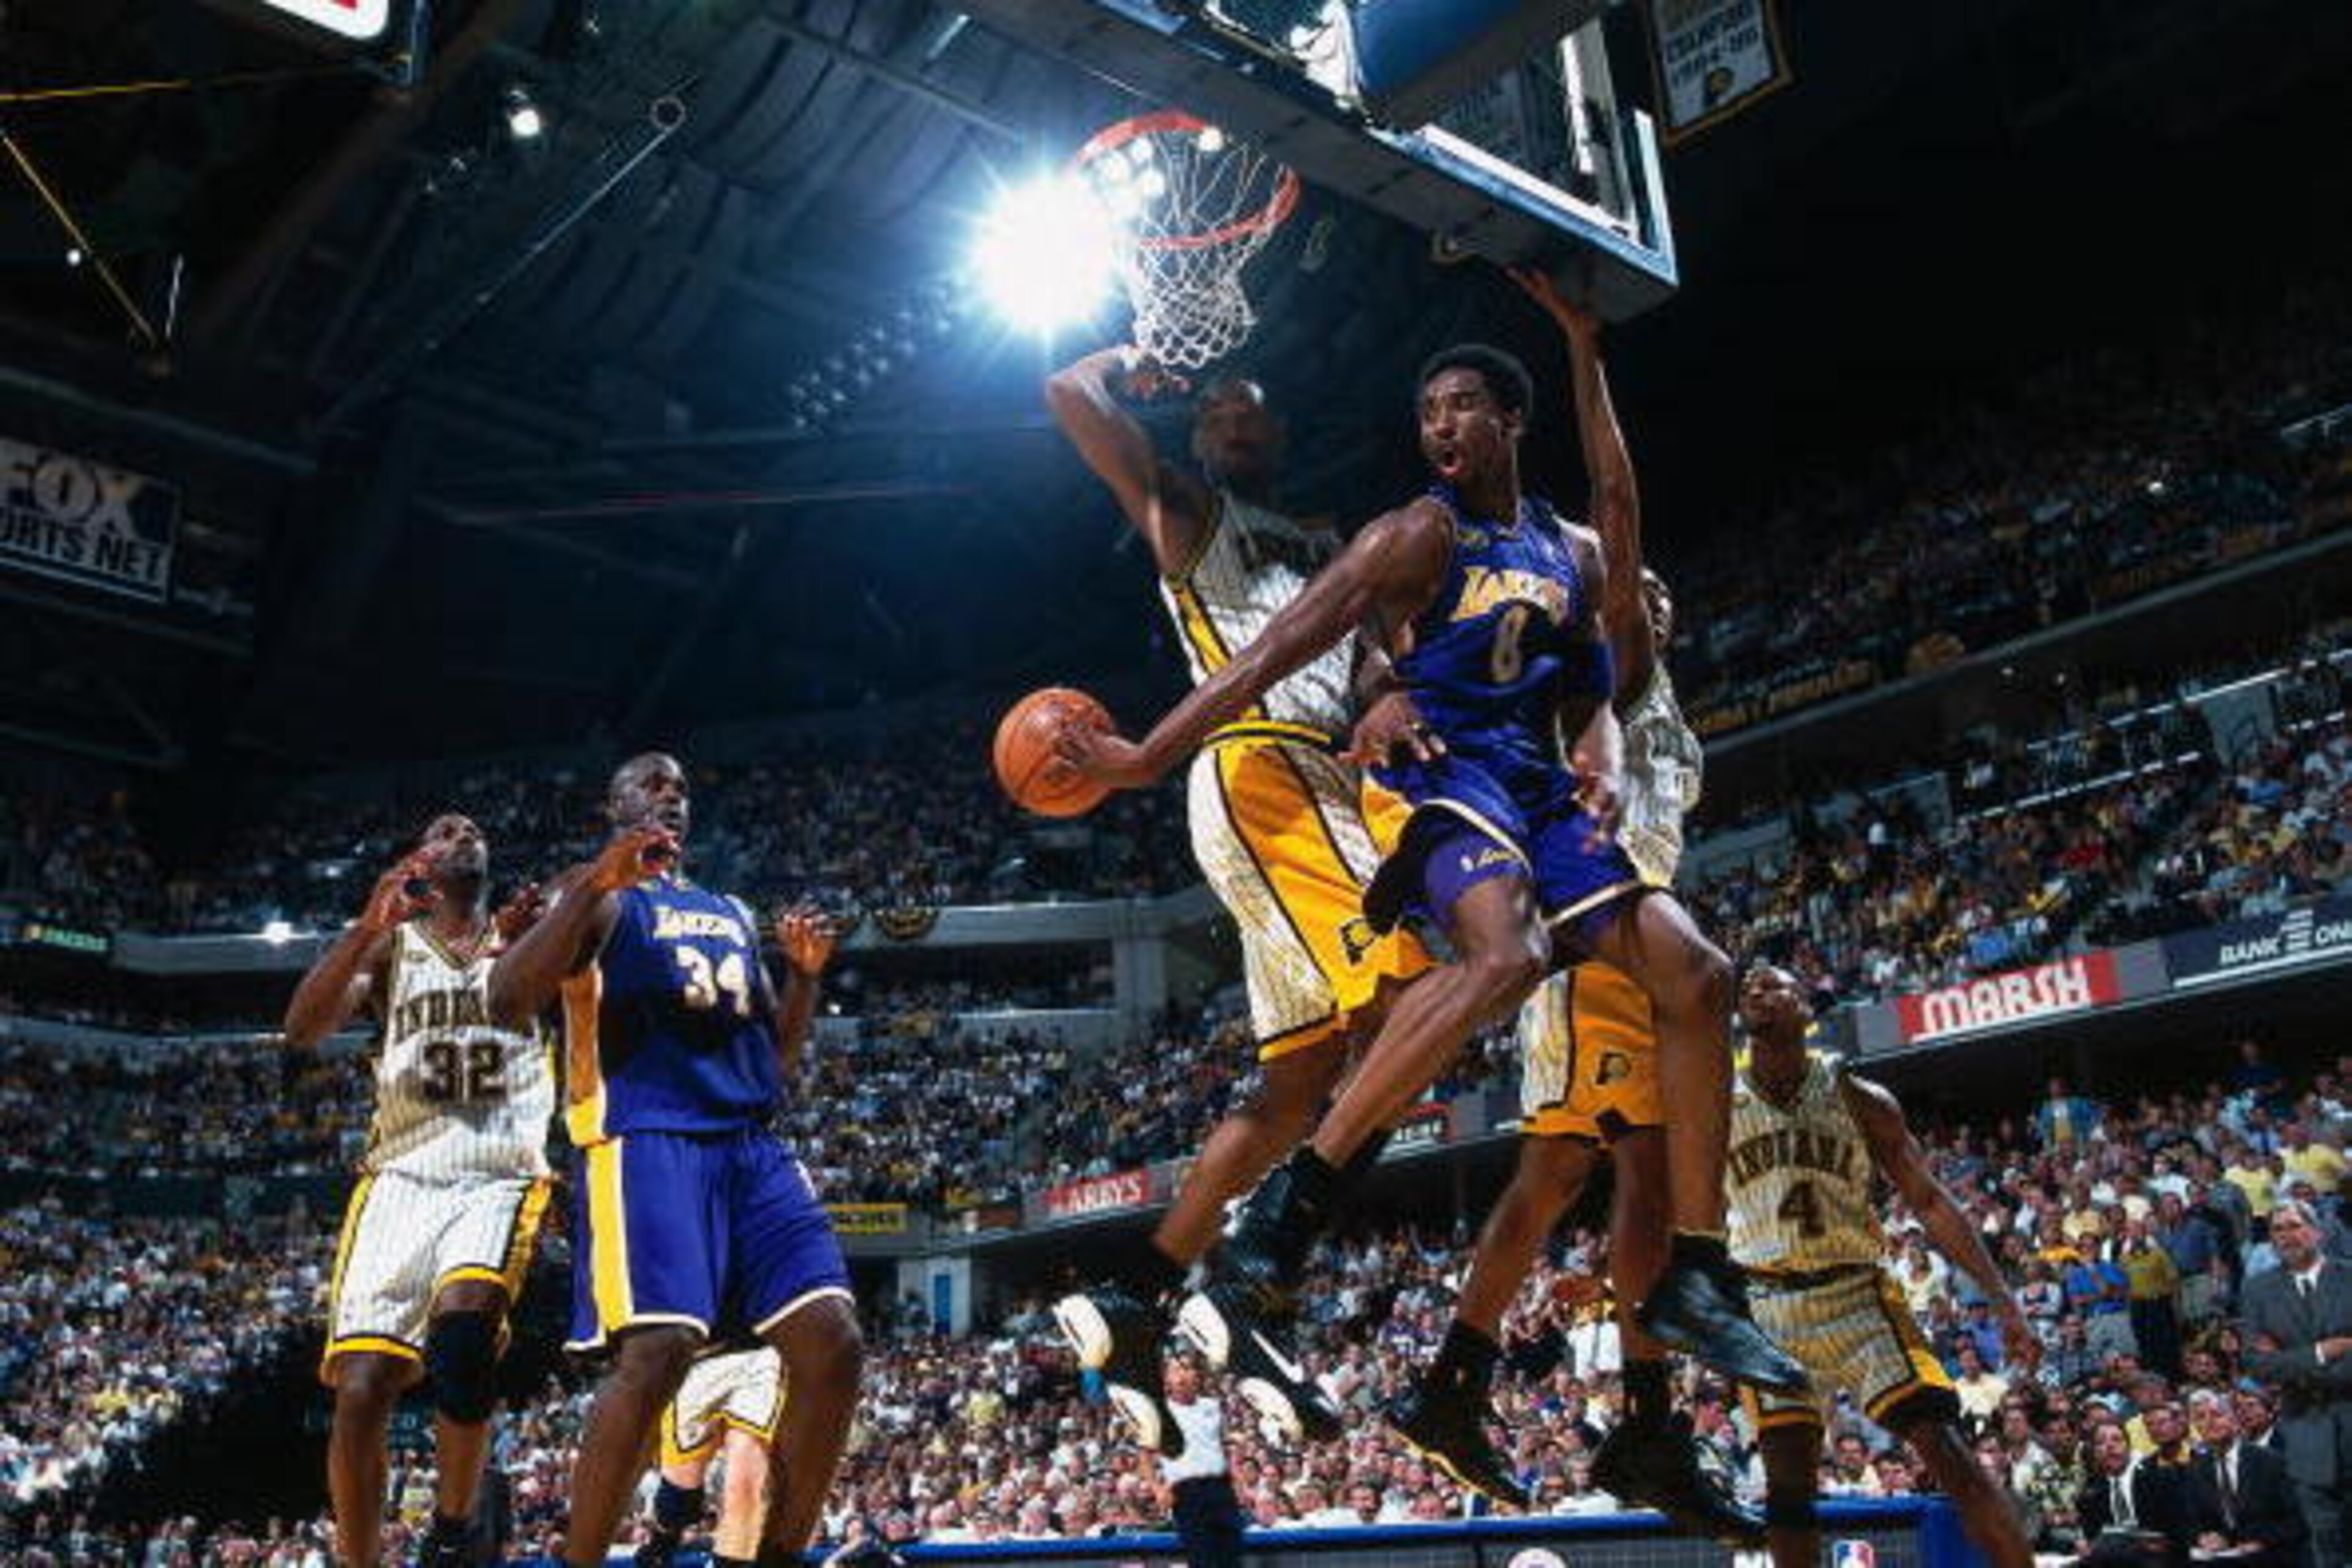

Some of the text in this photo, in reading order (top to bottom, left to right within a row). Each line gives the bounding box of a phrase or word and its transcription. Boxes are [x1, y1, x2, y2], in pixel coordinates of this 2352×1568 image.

[94, 532, 164, 581] NET
[2220, 936, 2280, 966] BANK
[676, 946, 750, 1017] 34
[1923, 957, 2091, 1034] MARSH
[423, 1041, 508, 1105] 32
[1728, 1128, 1854, 1187] INDIANA
[1777, 1181, 1827, 1238] 4
